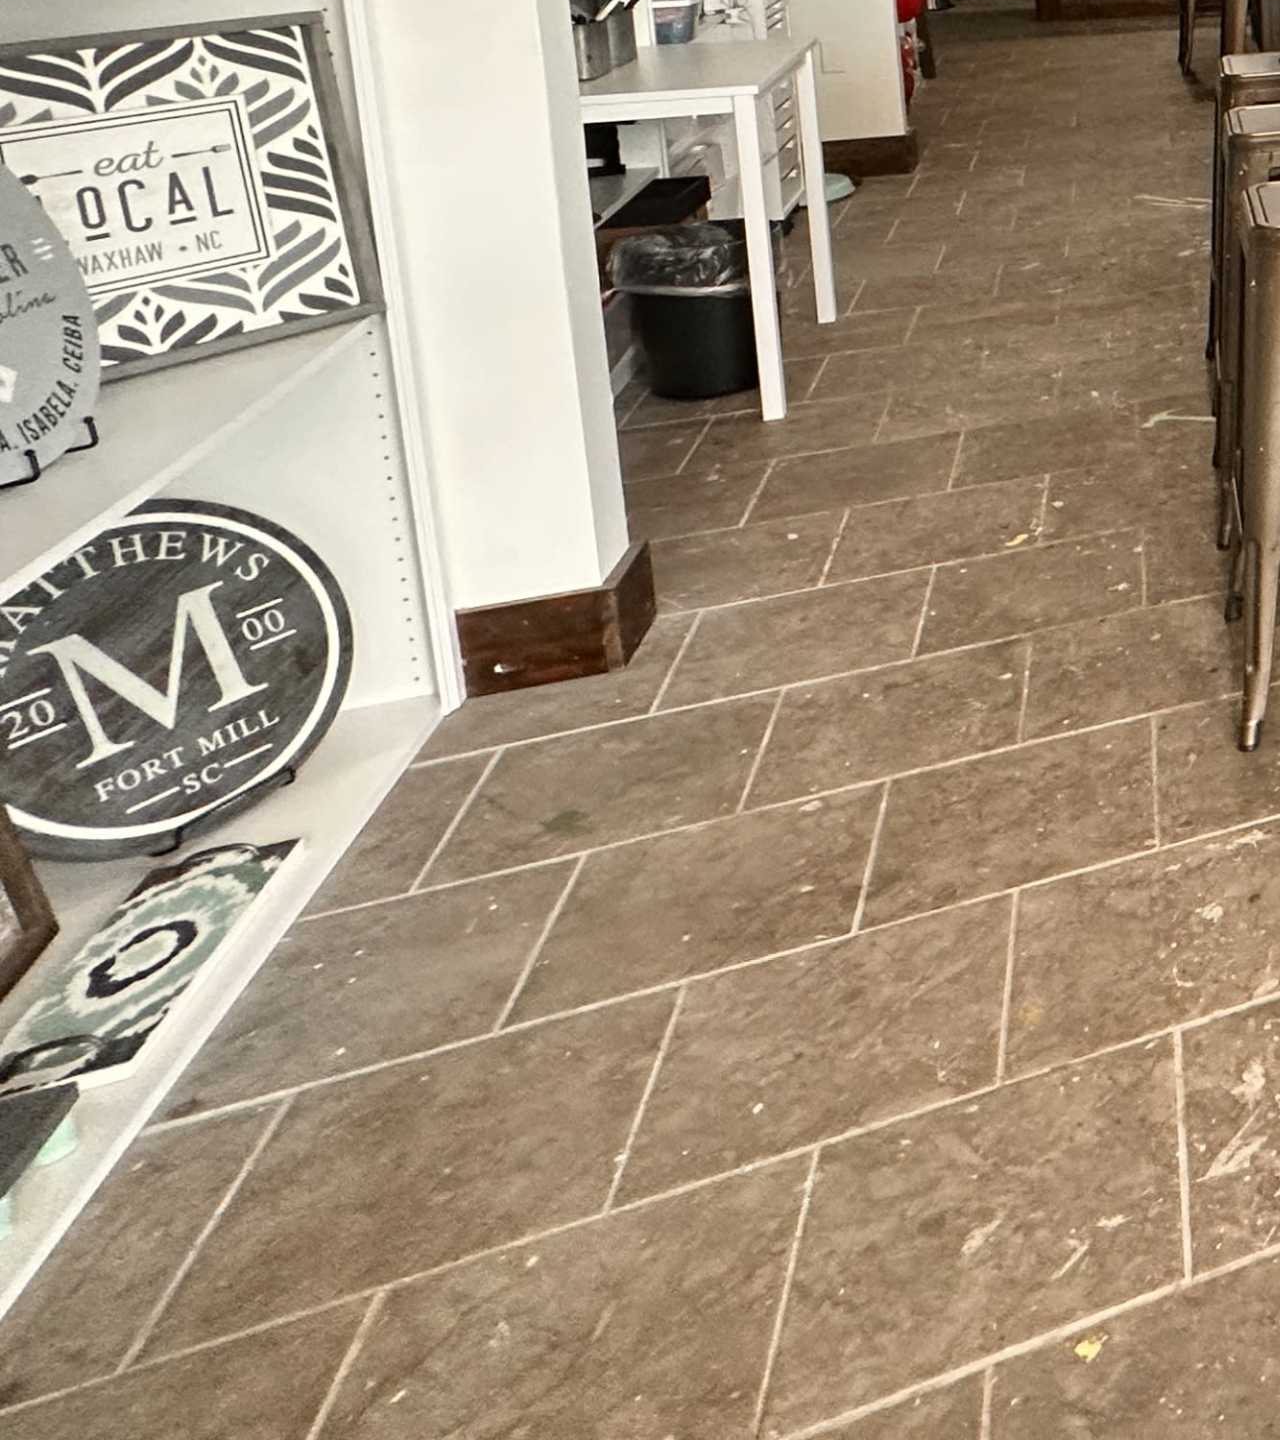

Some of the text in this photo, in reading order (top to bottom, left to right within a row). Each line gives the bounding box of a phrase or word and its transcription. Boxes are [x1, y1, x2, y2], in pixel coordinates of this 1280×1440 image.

[94, 140, 164, 177] eat
[76, 165, 235, 235] OCAL
[195, 230, 223, 253] NC
[62, 314, 83, 373] CEIBA
[2, 580, 286, 770] 20 M 00
[93, 709, 281, 803] FORT MILL
[182, 762, 225, 796] SC
